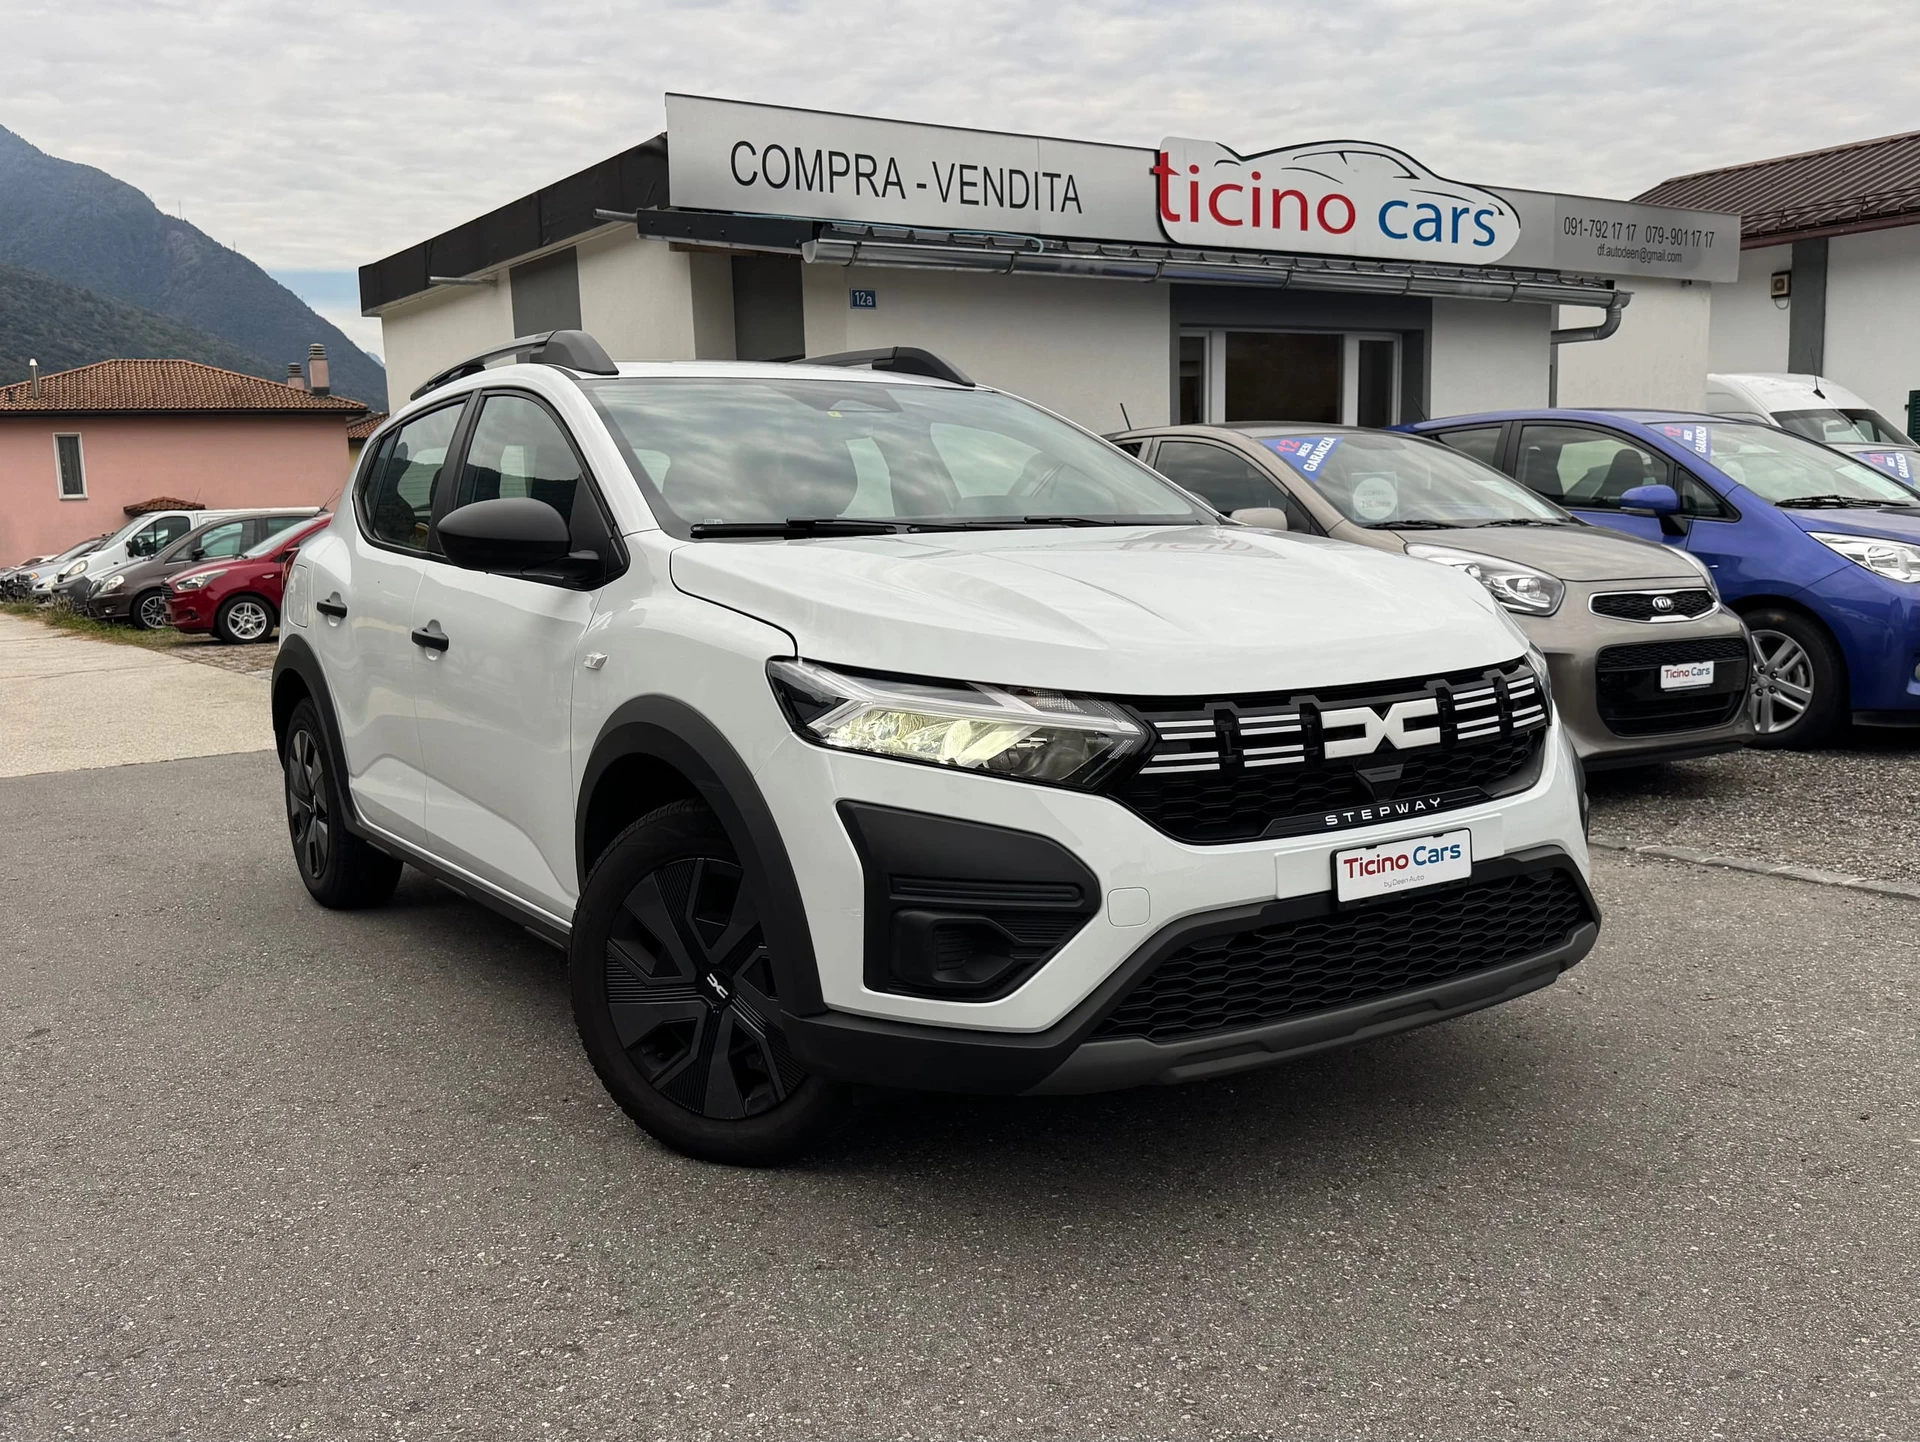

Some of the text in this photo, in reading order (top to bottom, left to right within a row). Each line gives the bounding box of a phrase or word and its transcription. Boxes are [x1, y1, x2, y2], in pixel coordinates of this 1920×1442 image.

[730, 141, 906, 200] COMPRA
[932, 161, 1083, 215] VENDITA
[1153, 151, 1496, 247] ticino cars
[1563, 216, 1608, 239] 091-792
[1597, 243, 1683, 264] df.autodeen@gmail.com
[855, 291, 873, 306] 12a
[1276, 439, 1300, 452] 12
[1303, 437, 1336, 471] GARANZIA
[1664, 666, 1710, 679] Ticino Cars
[1325, 797, 1441, 826] STEPWAY
[1343, 843, 1461, 879] Ticino Cars
